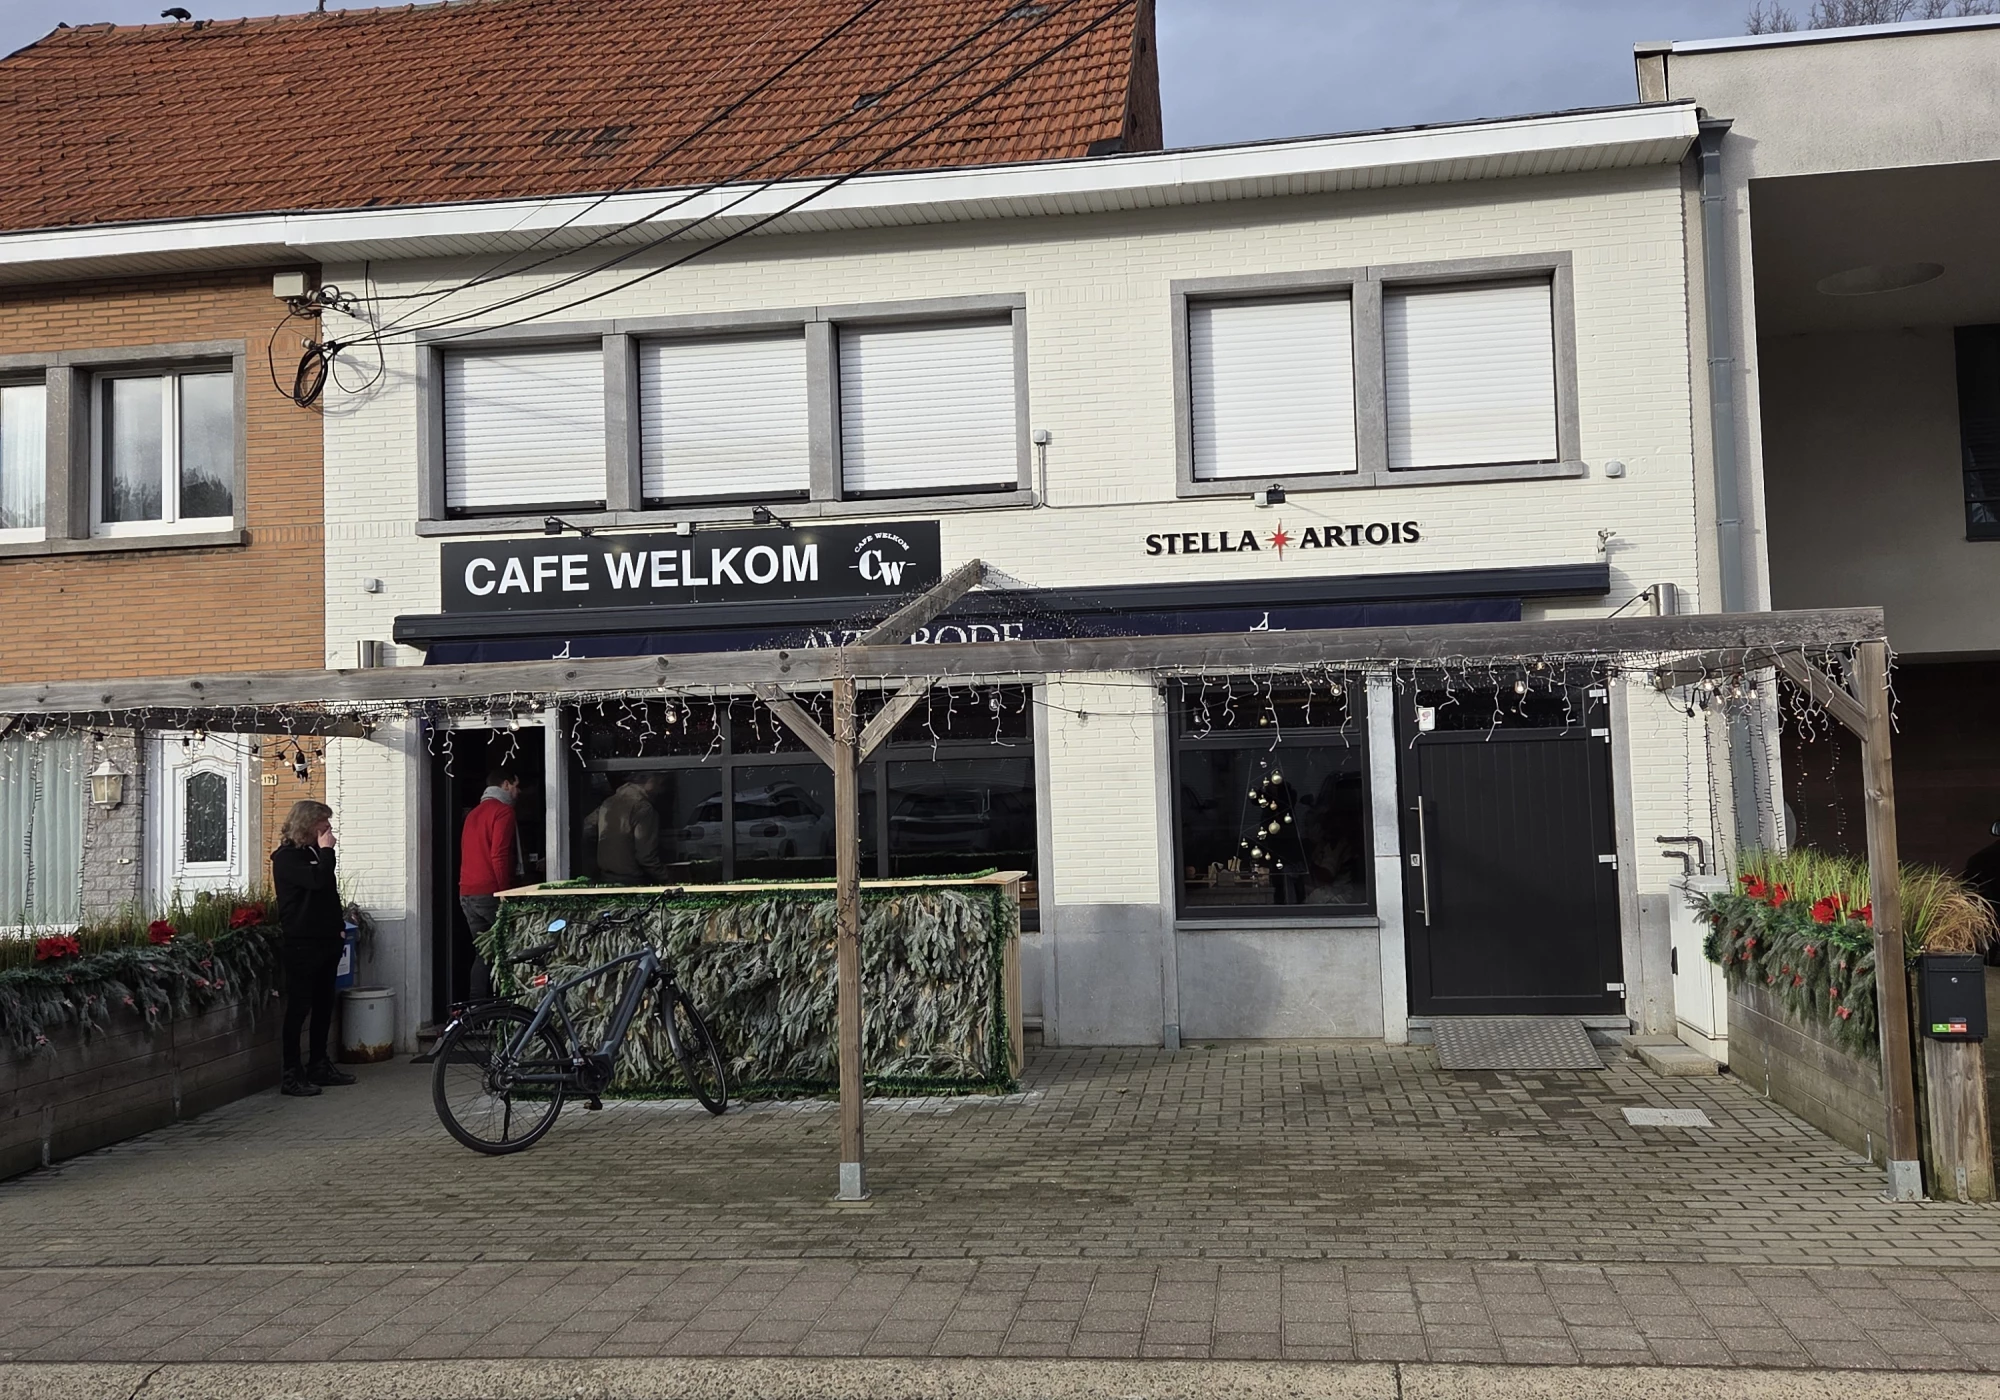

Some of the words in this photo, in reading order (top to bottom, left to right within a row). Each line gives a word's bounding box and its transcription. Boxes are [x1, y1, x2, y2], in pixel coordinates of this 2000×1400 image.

[854, 535, 874, 553] CAFE
[874, 532, 910, 552] WELKOM
[1146, 530, 1261, 556] STELLA
[1299, 521, 1420, 549] ARTOIS
[464, 554, 590, 596] CAFE
[603, 543, 819, 590] WELKOM
[858, 549, 906, 586] CW
